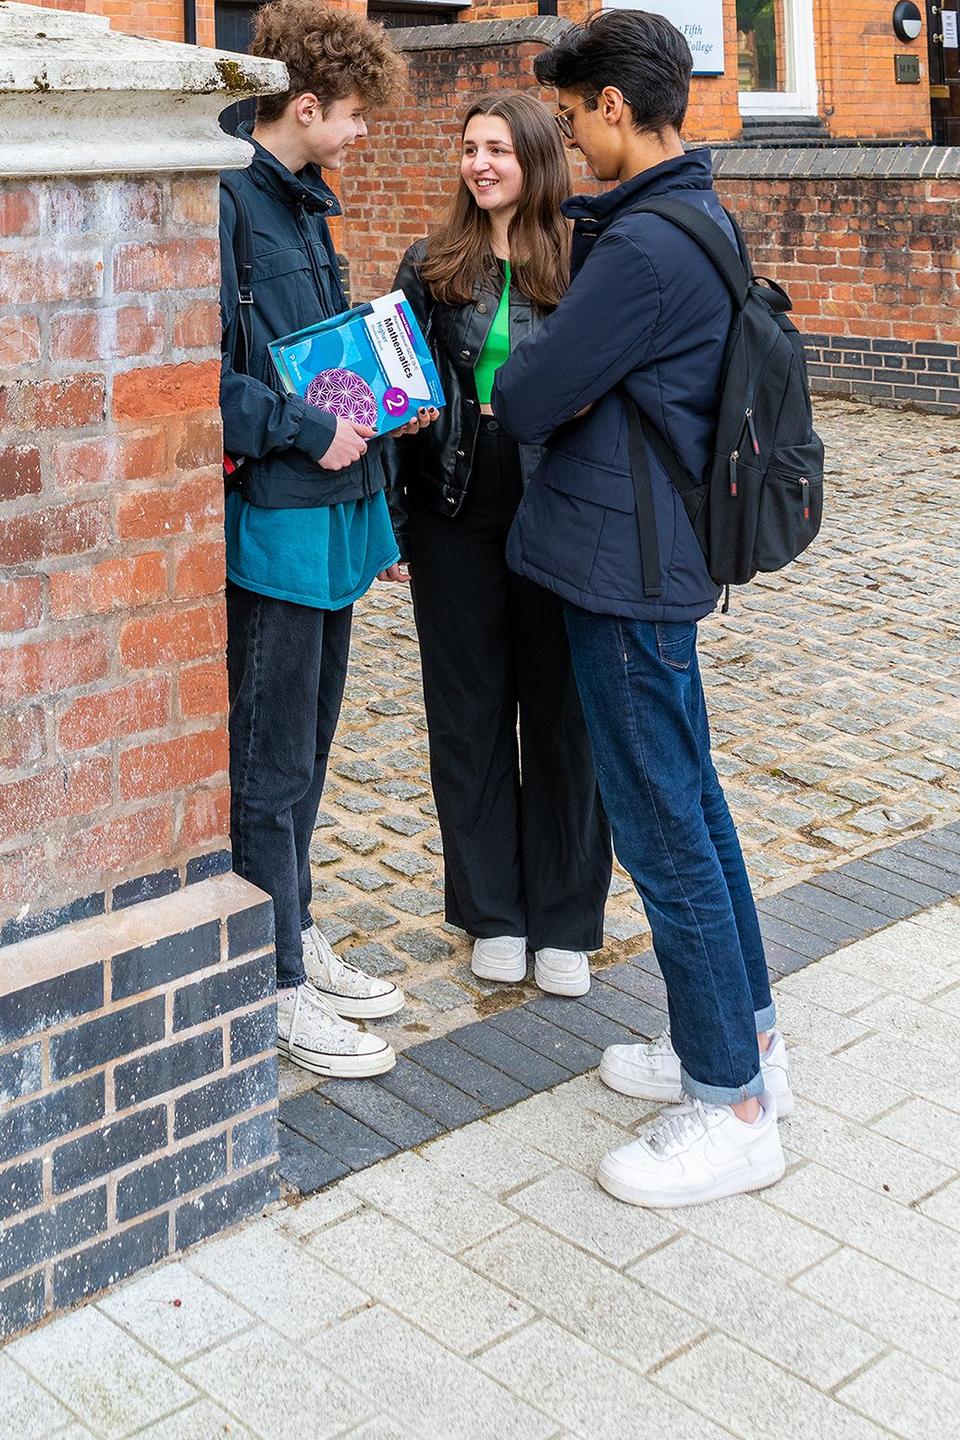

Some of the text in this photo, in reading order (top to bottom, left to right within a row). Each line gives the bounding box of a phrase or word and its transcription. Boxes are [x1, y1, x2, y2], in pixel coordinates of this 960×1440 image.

[684, 24, 702, 38] Fifth
[688, 40, 713, 54] ollege
[376, 321, 388, 343] Higher
[384, 318, 413, 379] Mathematics
[386, 394, 404, 410] 2
